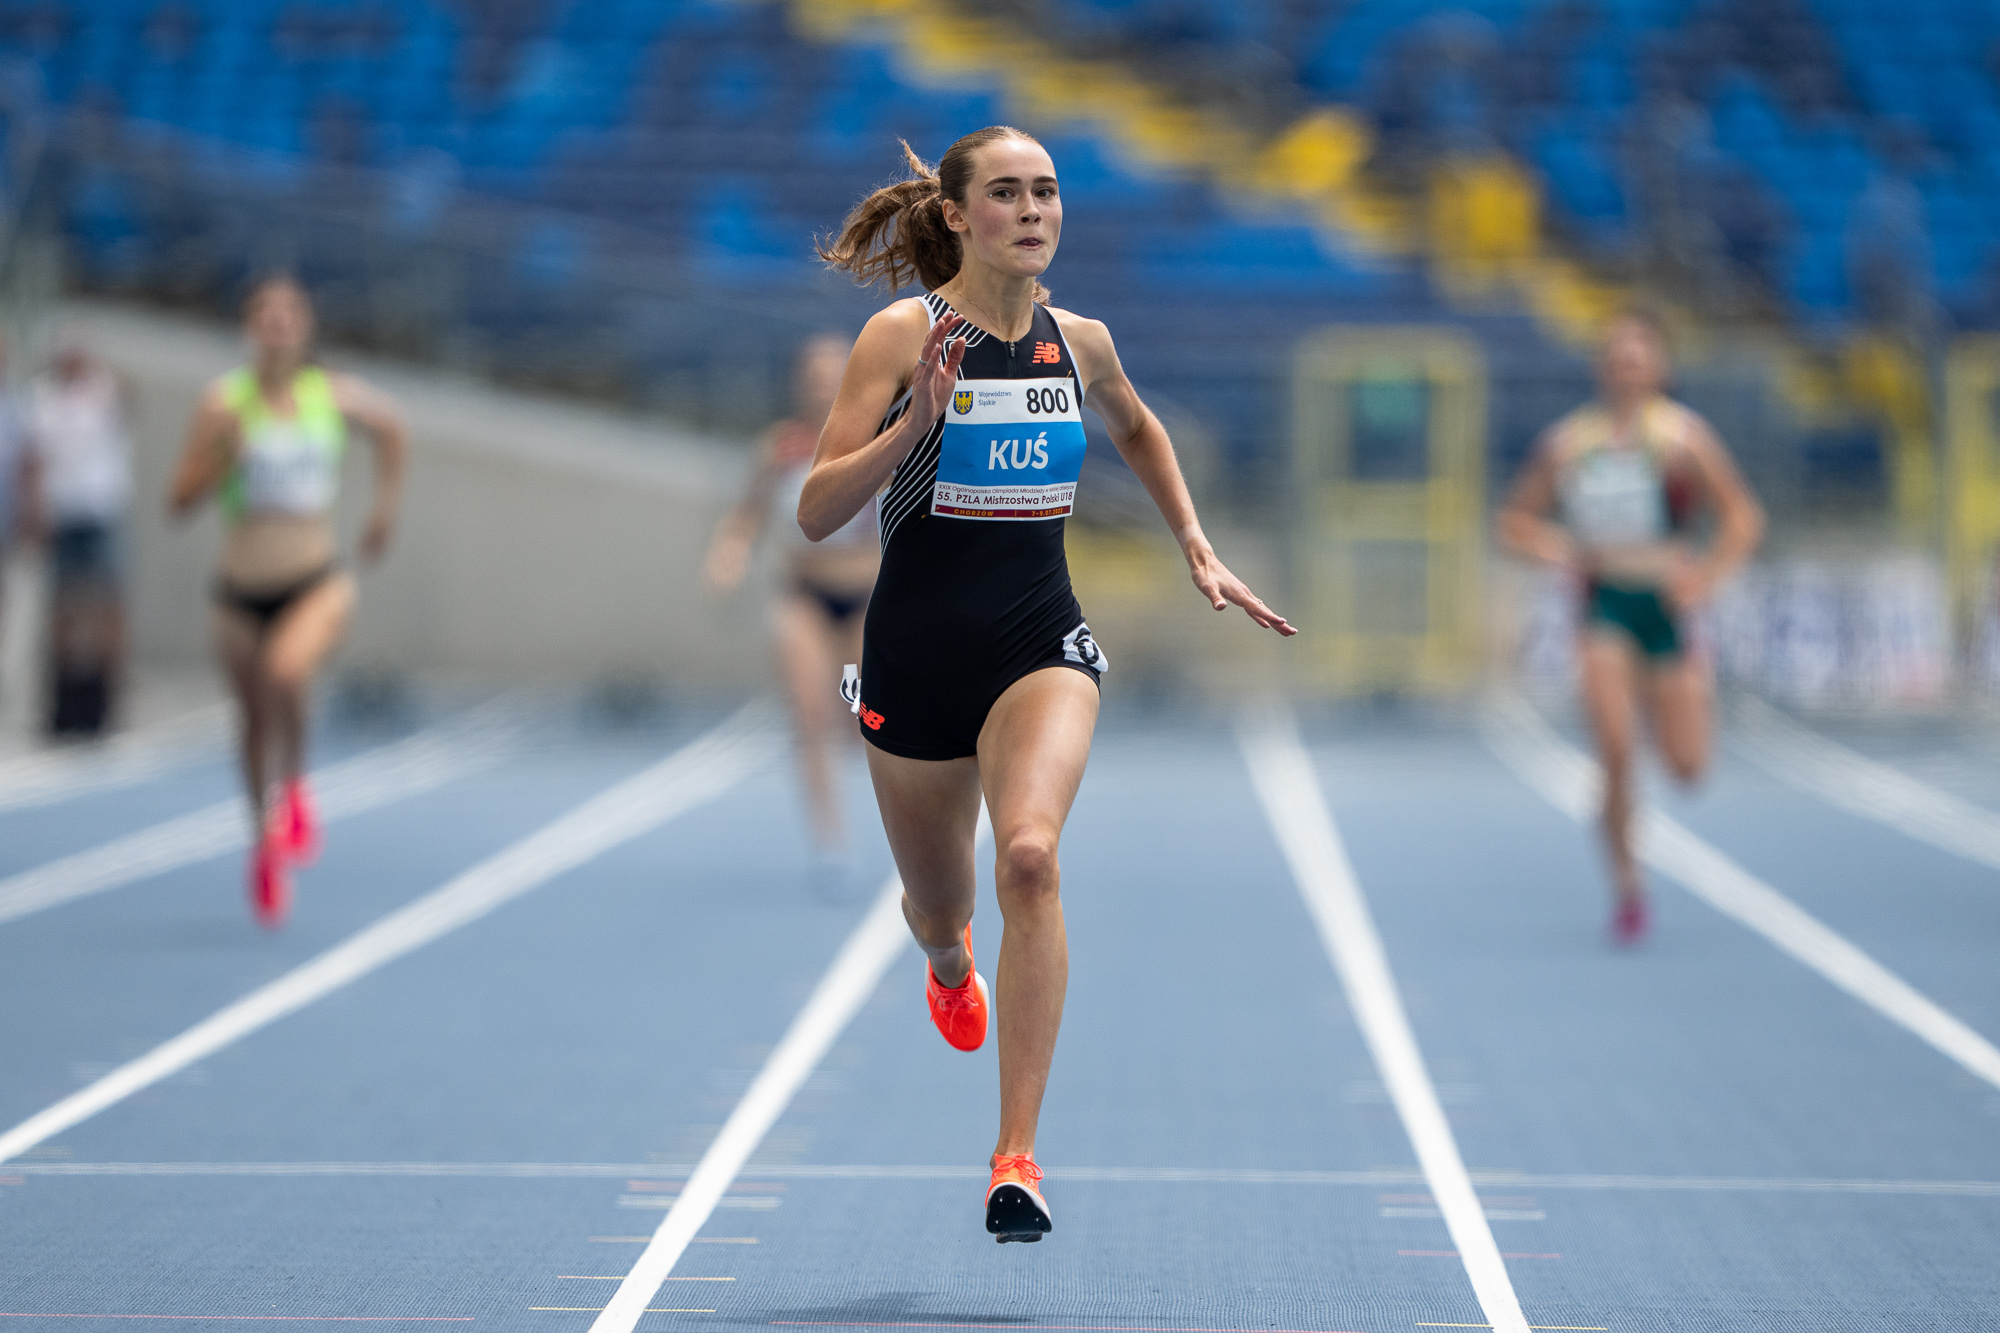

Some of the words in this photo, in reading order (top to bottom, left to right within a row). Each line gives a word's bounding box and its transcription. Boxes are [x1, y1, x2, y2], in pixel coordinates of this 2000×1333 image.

[1026, 387, 1069, 414] 800
[988, 431, 1049, 470] KUŚ
[936, 491, 952, 502] 55.
[956, 493, 980, 505] PZLA
[983, 495, 1039, 505] Mistrzostwa
[1041, 493, 1060, 505] Polski
[1060, 491, 1073, 502] U18
[954, 508, 994, 517] CHORZÓW
